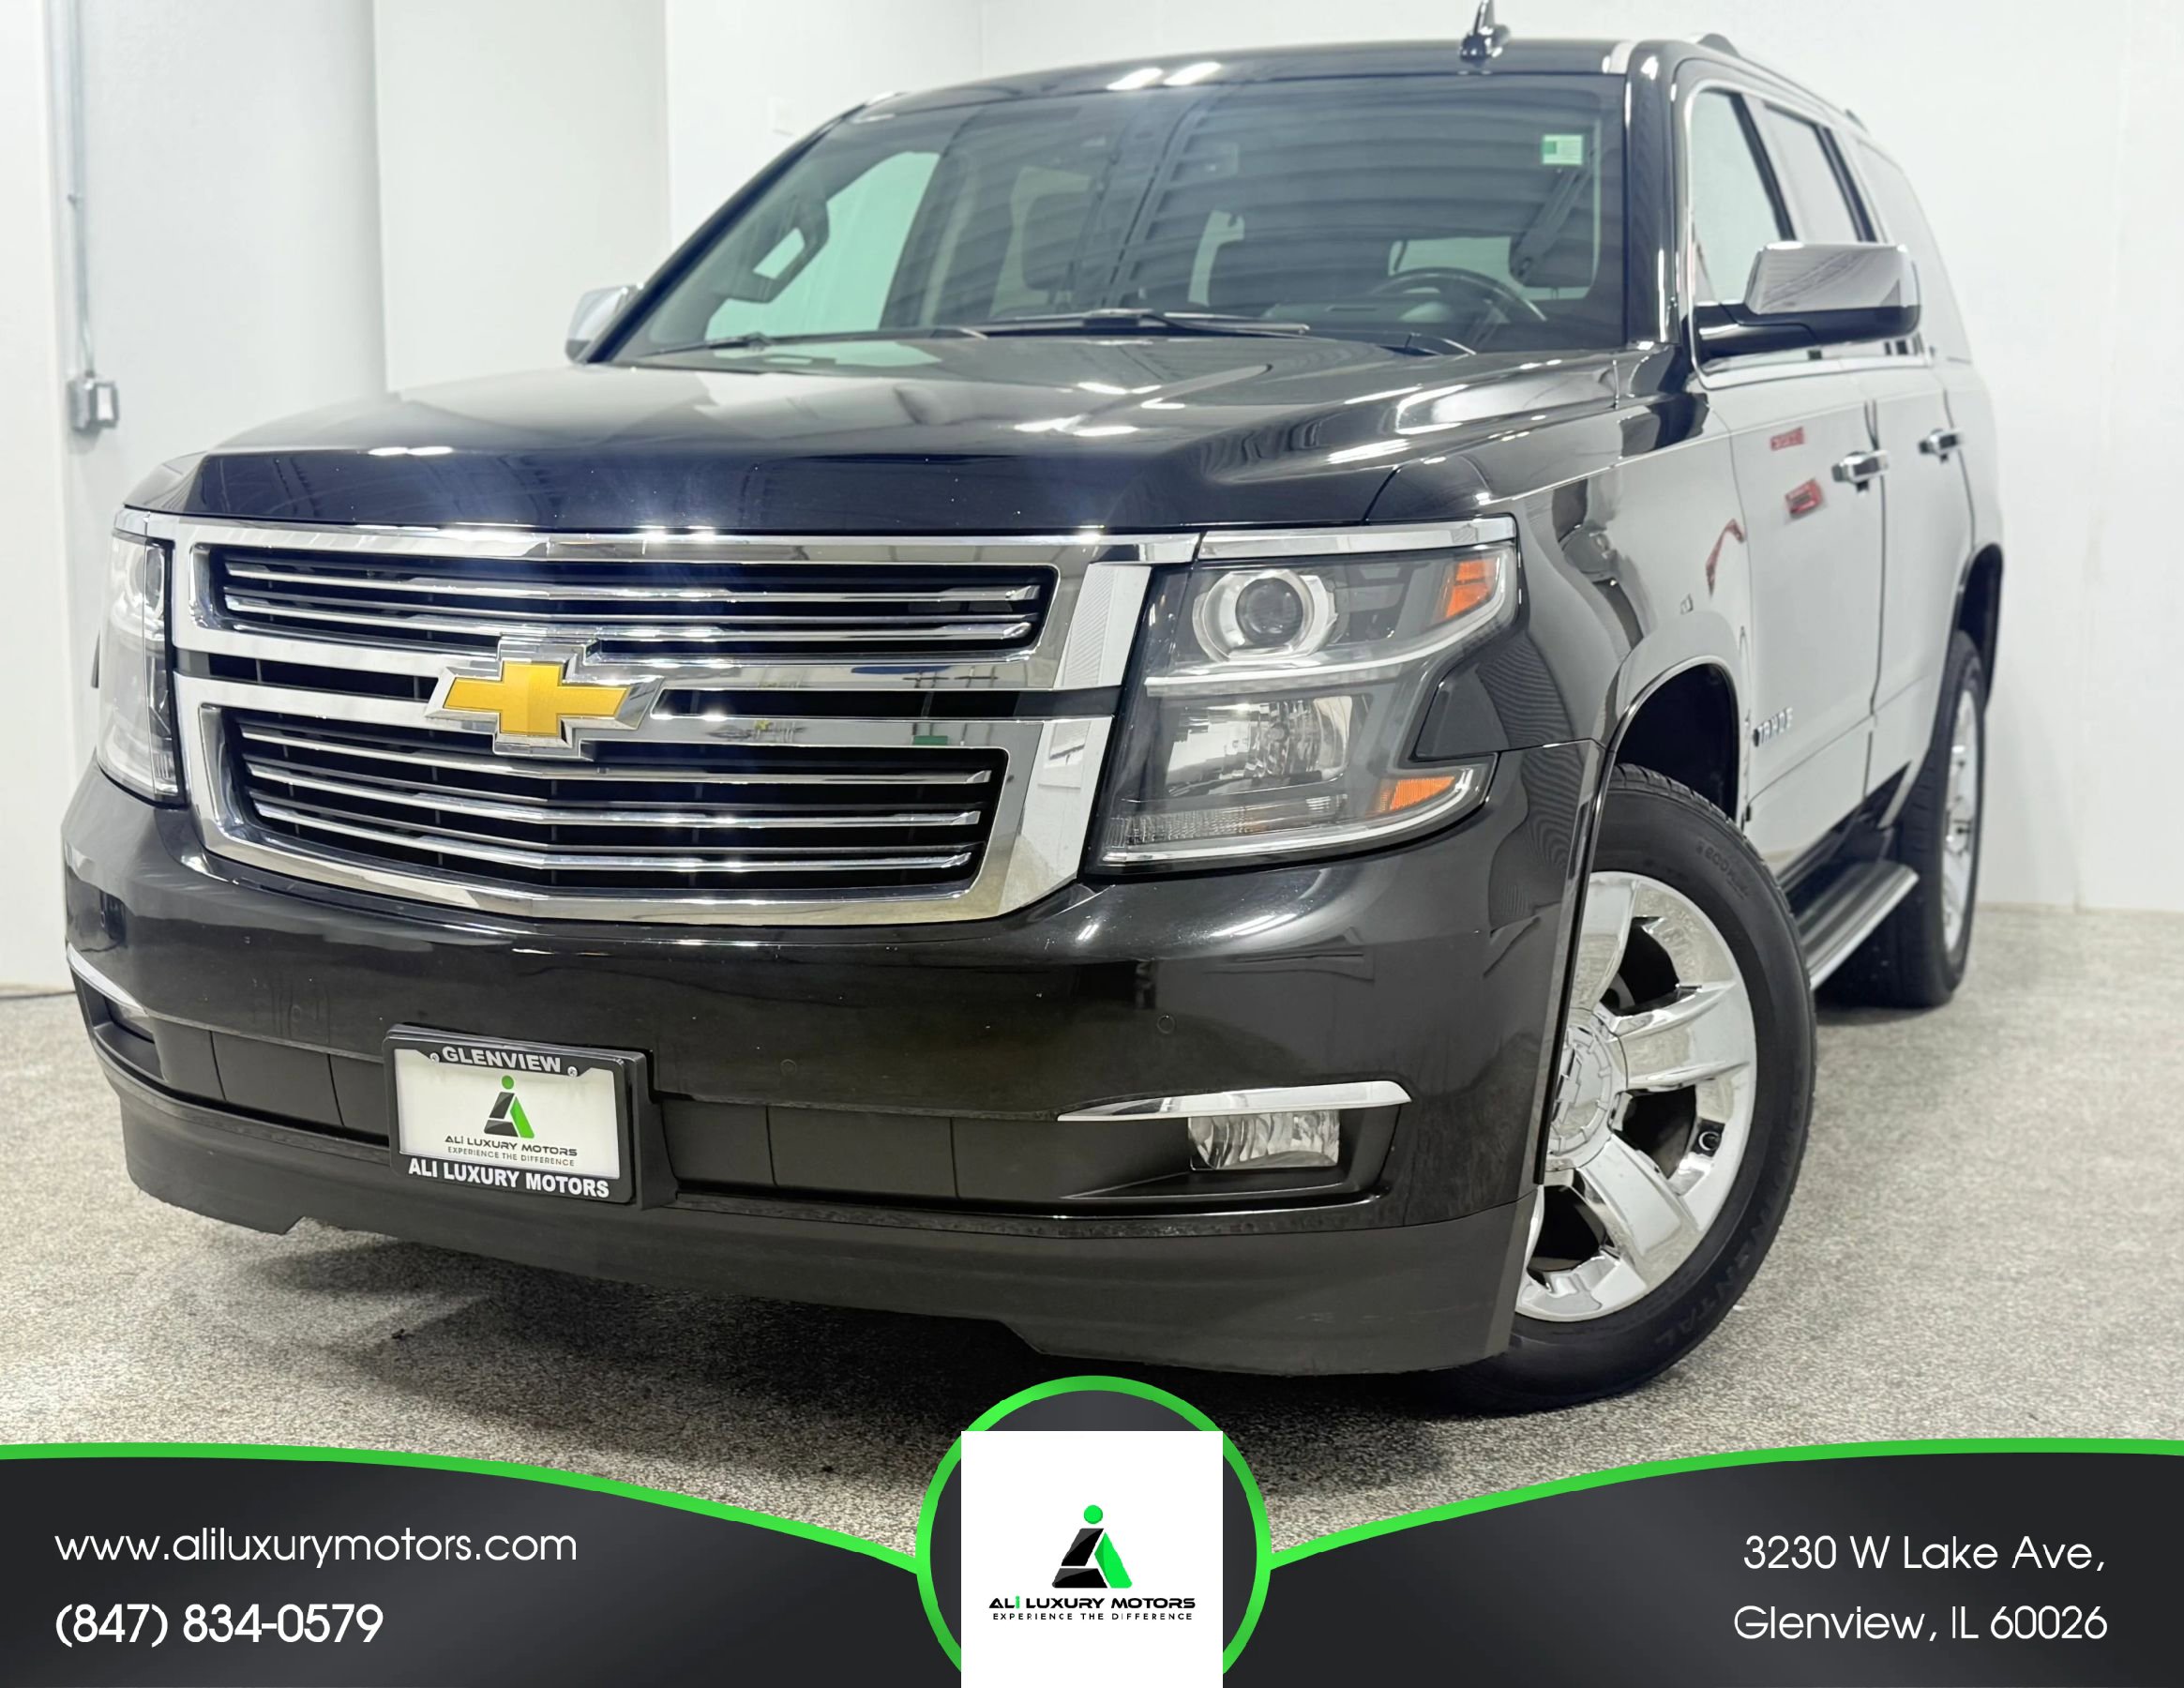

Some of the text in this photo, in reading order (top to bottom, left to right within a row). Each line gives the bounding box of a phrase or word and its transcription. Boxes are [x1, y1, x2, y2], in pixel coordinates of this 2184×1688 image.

[442, 1046, 561, 1073] GLENVIEW
[447, 1146, 575, 1167] EXPERIENCE THE DIFFERENCE
[467, 1137, 518, 1151] LUXURY
[521, 1143, 578, 1156] MOTORS
[408, 1157, 610, 1198] ALI LUXURY MOTORS
